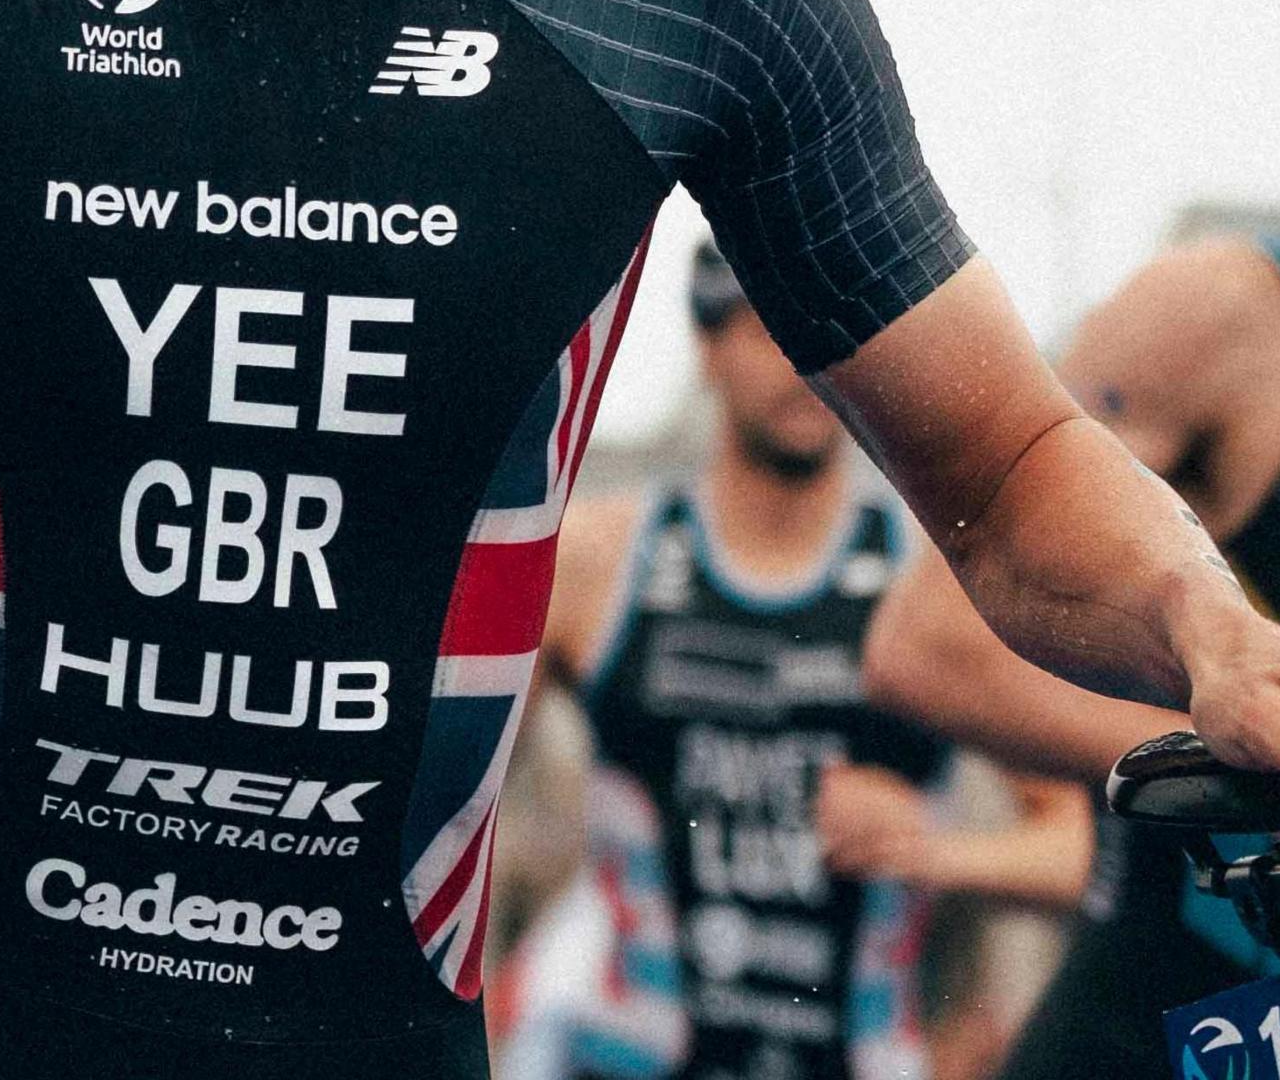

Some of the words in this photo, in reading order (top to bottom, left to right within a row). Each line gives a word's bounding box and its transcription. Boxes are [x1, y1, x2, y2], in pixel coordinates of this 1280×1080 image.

[60, 46, 181, 78] Triathlon
[81, 23, 164, 50] World
[45, 180, 179, 230] new
[197, 180, 458, 246] balance
[87, 277, 415, 436] YEE
[120, 459, 344, 610] GBR
[40, 622, 390, 732] HUUB
[35, 738, 383, 823] TREK
[40, 795, 211, 843] FACTORY
[214, 824, 361, 857] RACING
[25, 858, 343, 951] Cadence
[99, 947, 254, 985] HYDRATION
